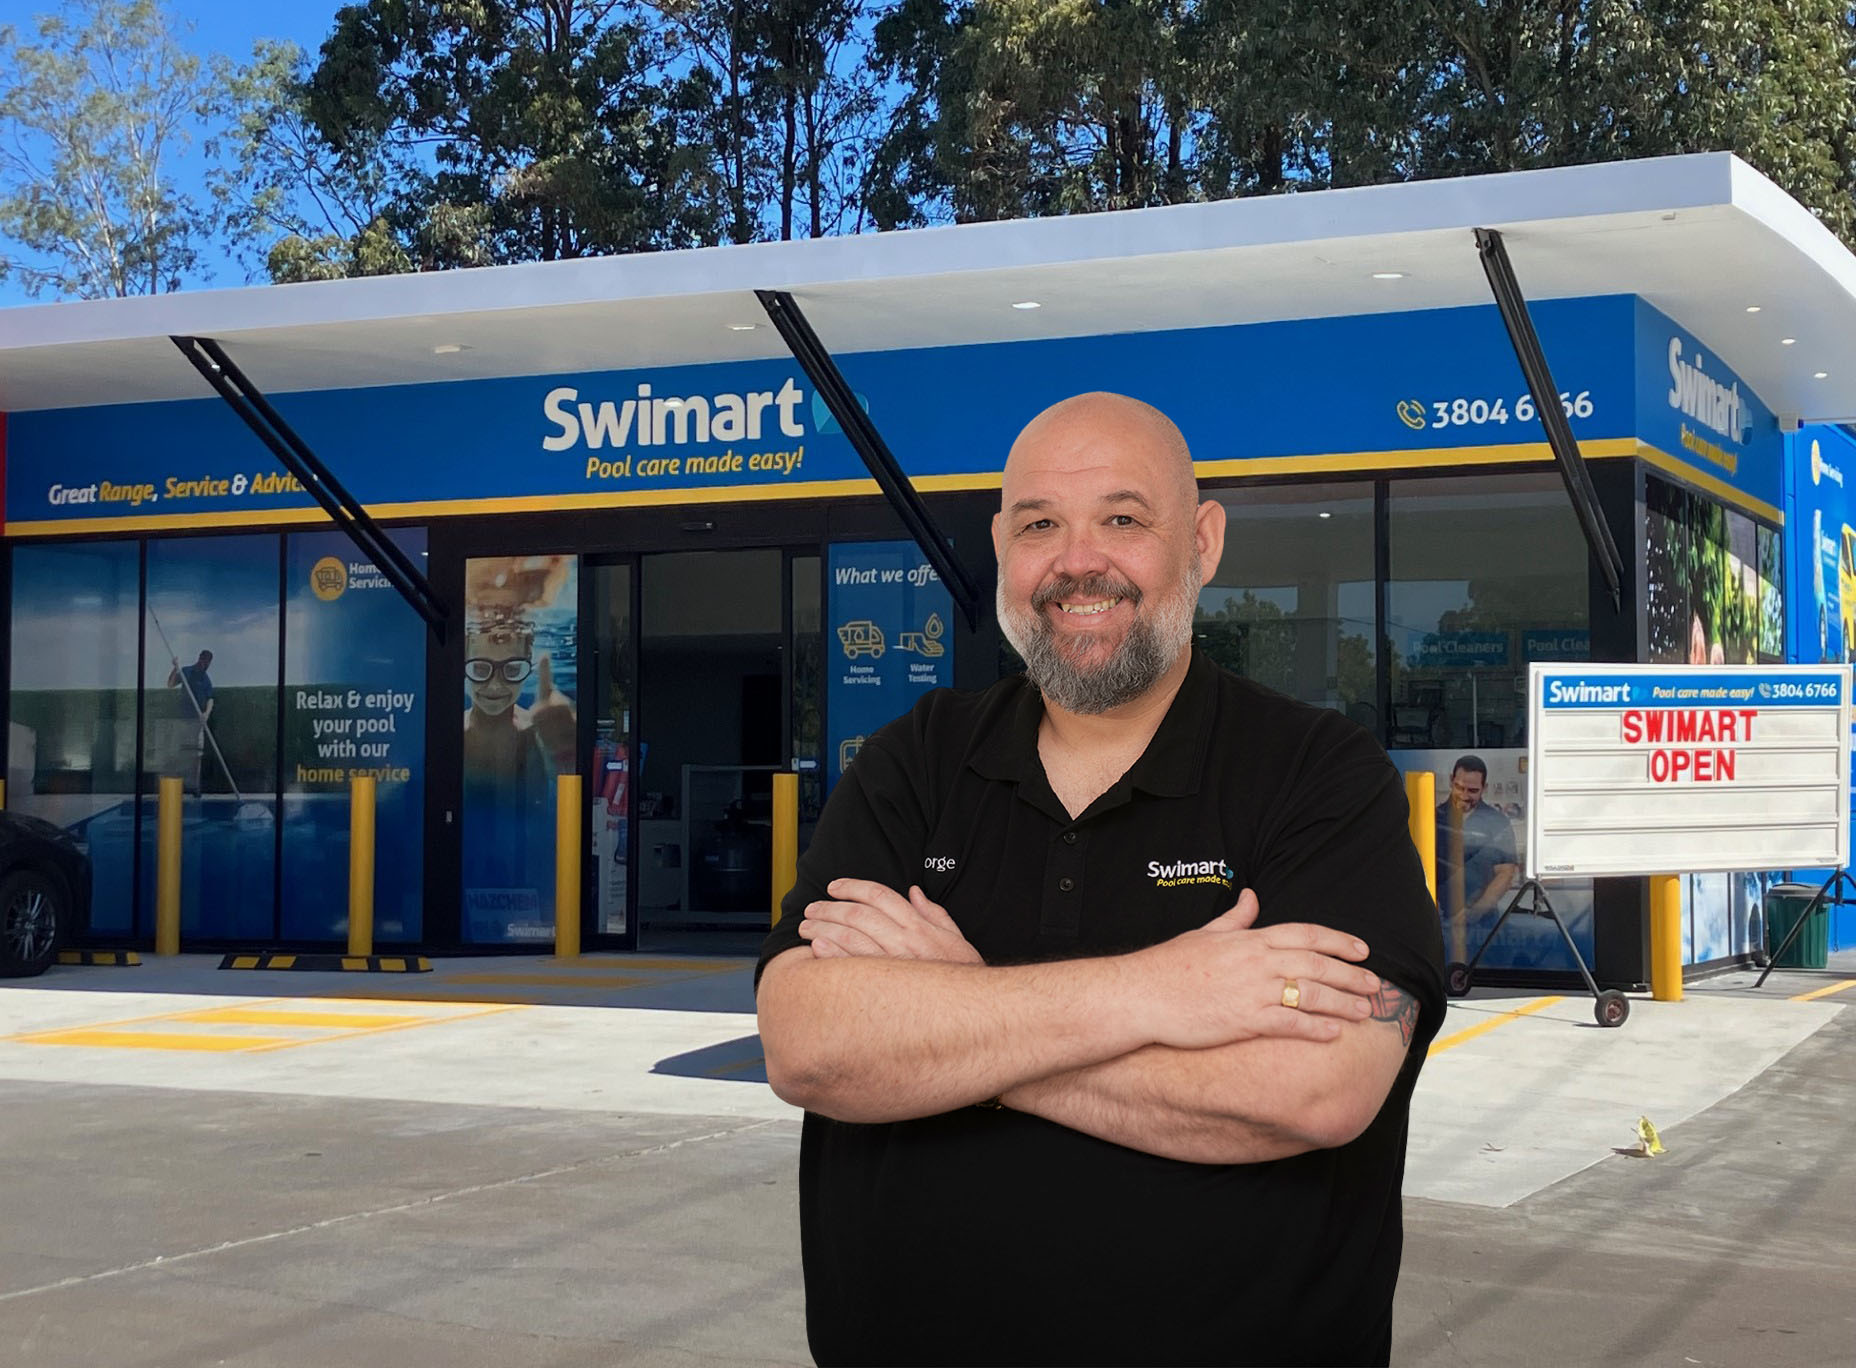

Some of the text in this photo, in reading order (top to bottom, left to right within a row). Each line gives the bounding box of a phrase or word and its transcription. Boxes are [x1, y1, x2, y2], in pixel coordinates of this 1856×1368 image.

[542, 377, 805, 451] Swimart
[1432, 390, 1594, 429] 3804 666
[586, 446, 804, 479] Pool care made easy!
[48, 470, 308, 506] Great Range, Service & Advic
[835, 564, 941, 587] What we offe
[850, 665, 874, 674] Home
[908, 673, 936, 684] Testing
[910, 664, 934, 672] Water
[843, 675, 880, 686] Servicing
[1549, 680, 1631, 703] Swimart
[1652, 686, 1676, 698] Pool
[1677, 688, 1699, 699] care
[1700, 687, 1728, 698] made
[1772, 683, 1804, 698] 3804
[1805, 682, 1837, 698] 6766
[296, 690, 415, 712] Relax & enjoy
[313, 715, 395, 738] your pool
[1623, 710, 1758, 743] SWIMART
[318, 741, 390, 758] with our
[297, 763, 410, 783] home service
[1651, 749, 1736, 782] OPEN
[1147, 860, 1226, 878] Swimart
[1157, 878, 1176, 887] Pool
[1176, 877, 1195, 886] care
[1196, 875, 1221, 885] made
